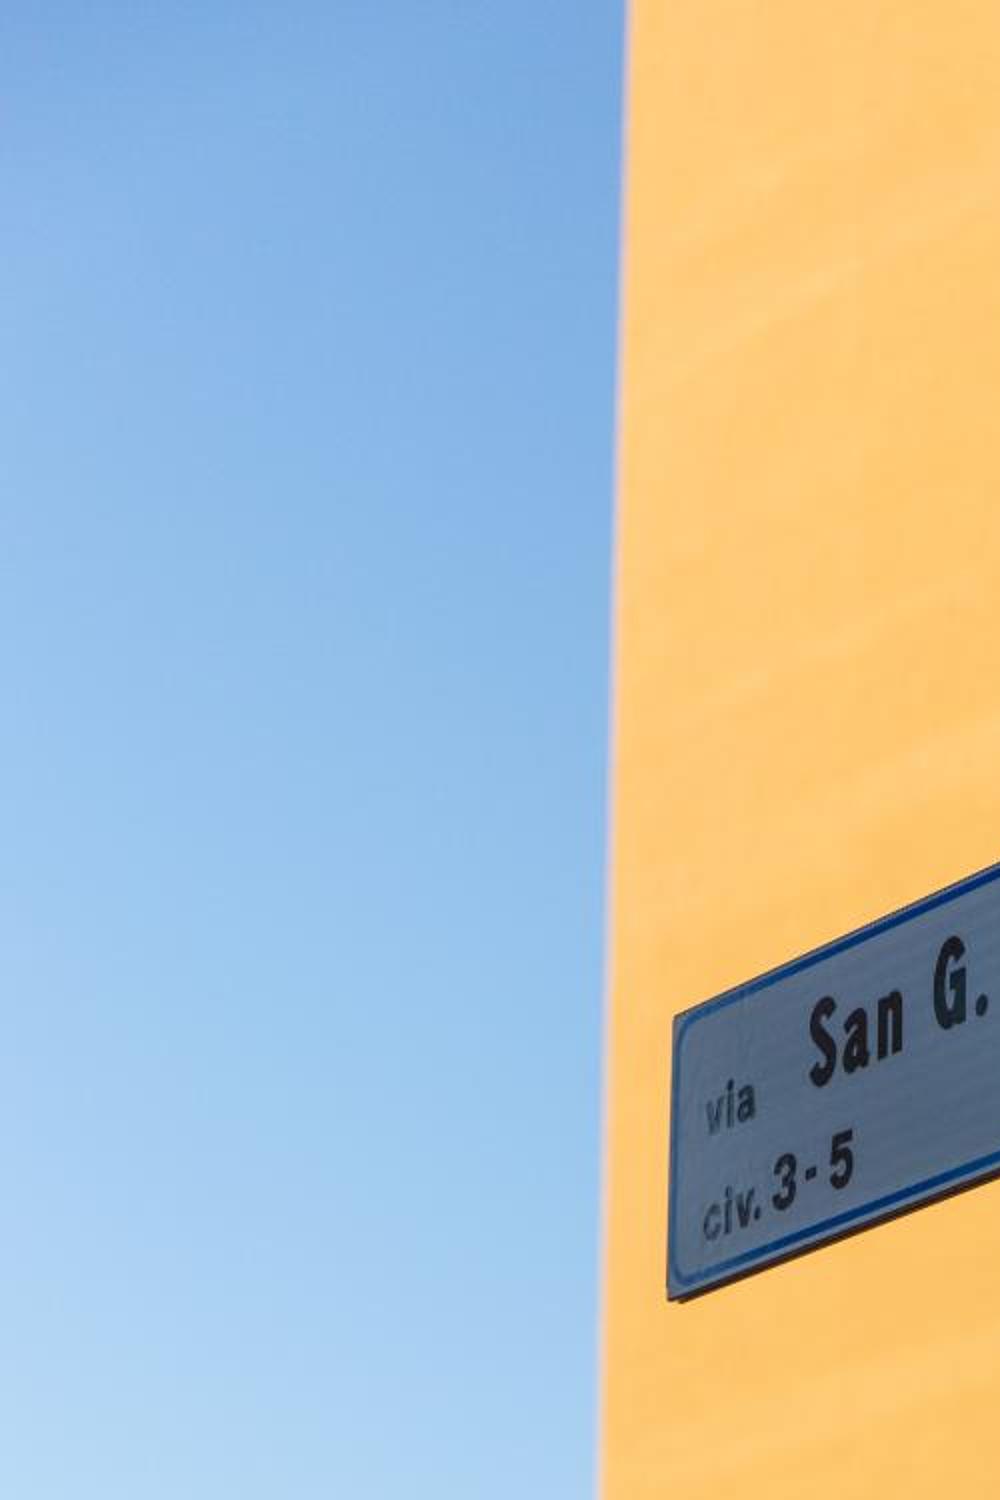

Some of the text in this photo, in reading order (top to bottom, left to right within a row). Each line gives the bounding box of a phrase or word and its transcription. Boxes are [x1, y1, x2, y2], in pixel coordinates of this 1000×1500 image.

[705, 1078, 756, 1136] via
[808, 988, 903, 1088] San
[933, 936, 989, 1031] G.
[702, 1187, 761, 1242] civ.
